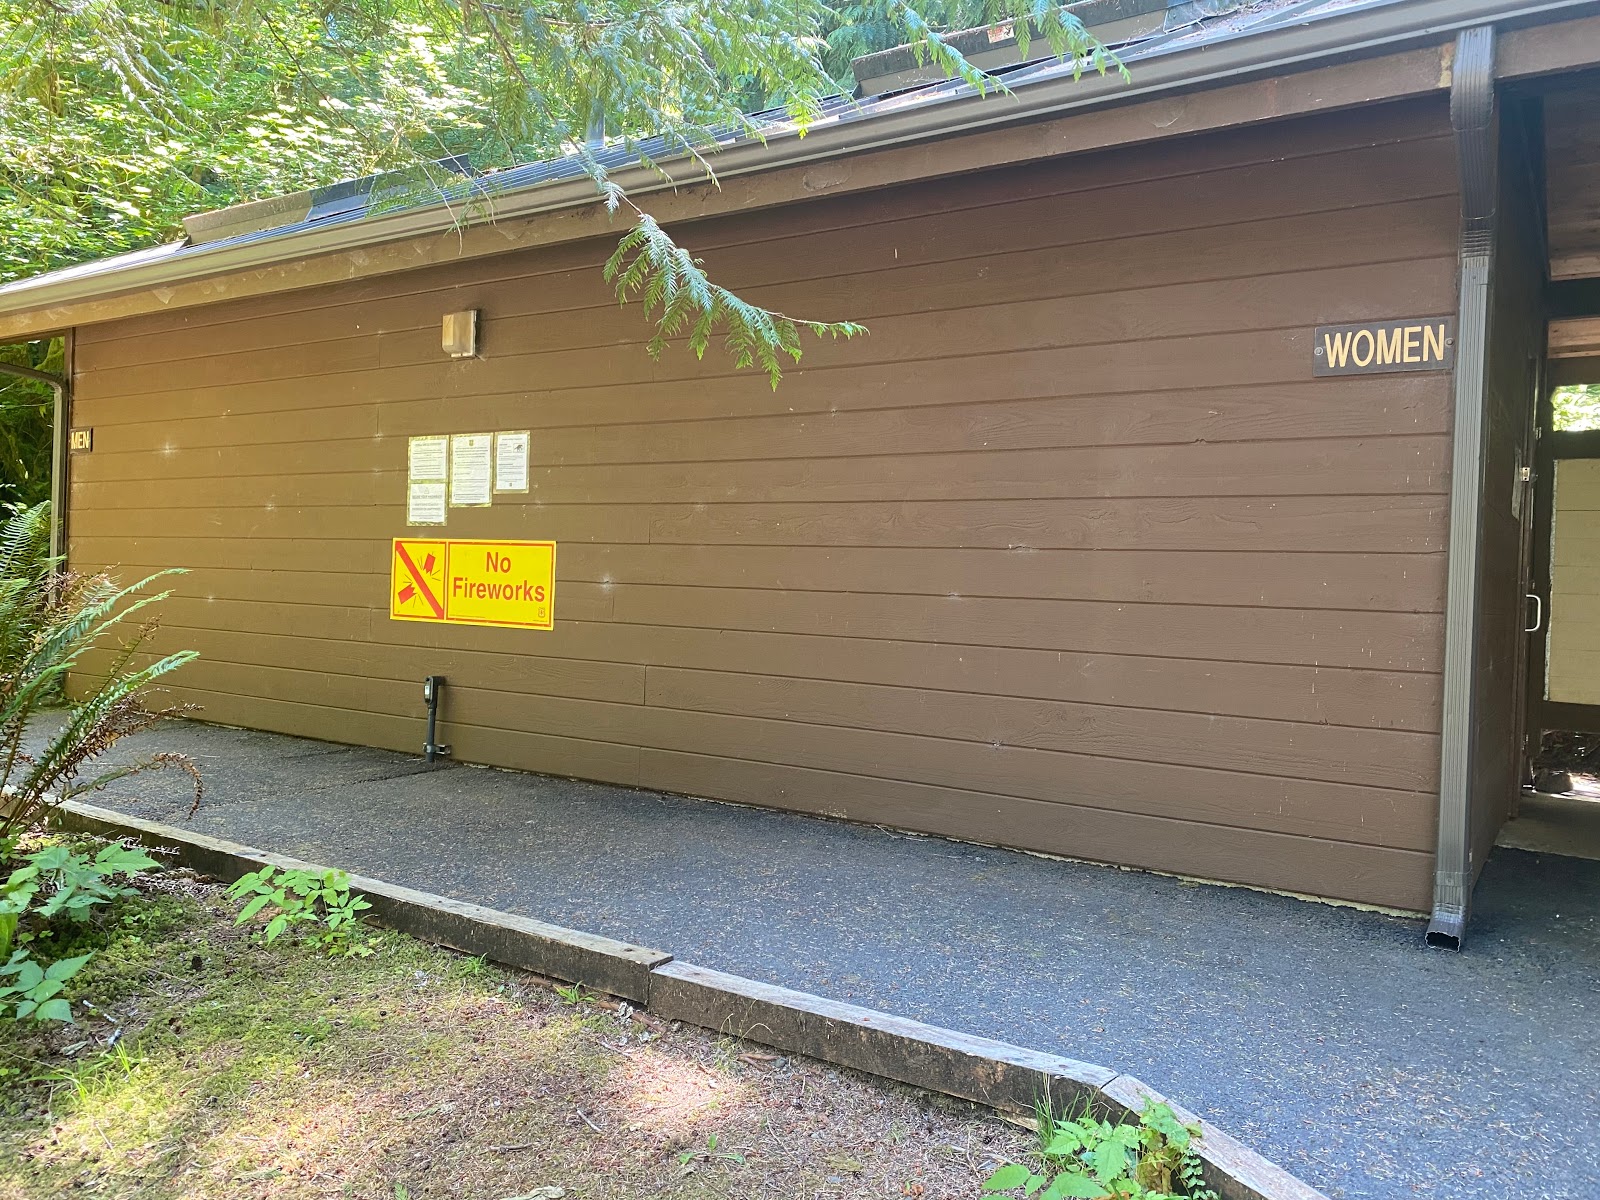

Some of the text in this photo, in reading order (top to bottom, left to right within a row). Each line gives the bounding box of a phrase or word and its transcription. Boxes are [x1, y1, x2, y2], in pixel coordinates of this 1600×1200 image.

[1324, 324, 1445, 368] WOMEN
[71, 430, 90, 449] MEN
[486, 551, 511, 573] No
[453, 577, 545, 602] Fireworks
